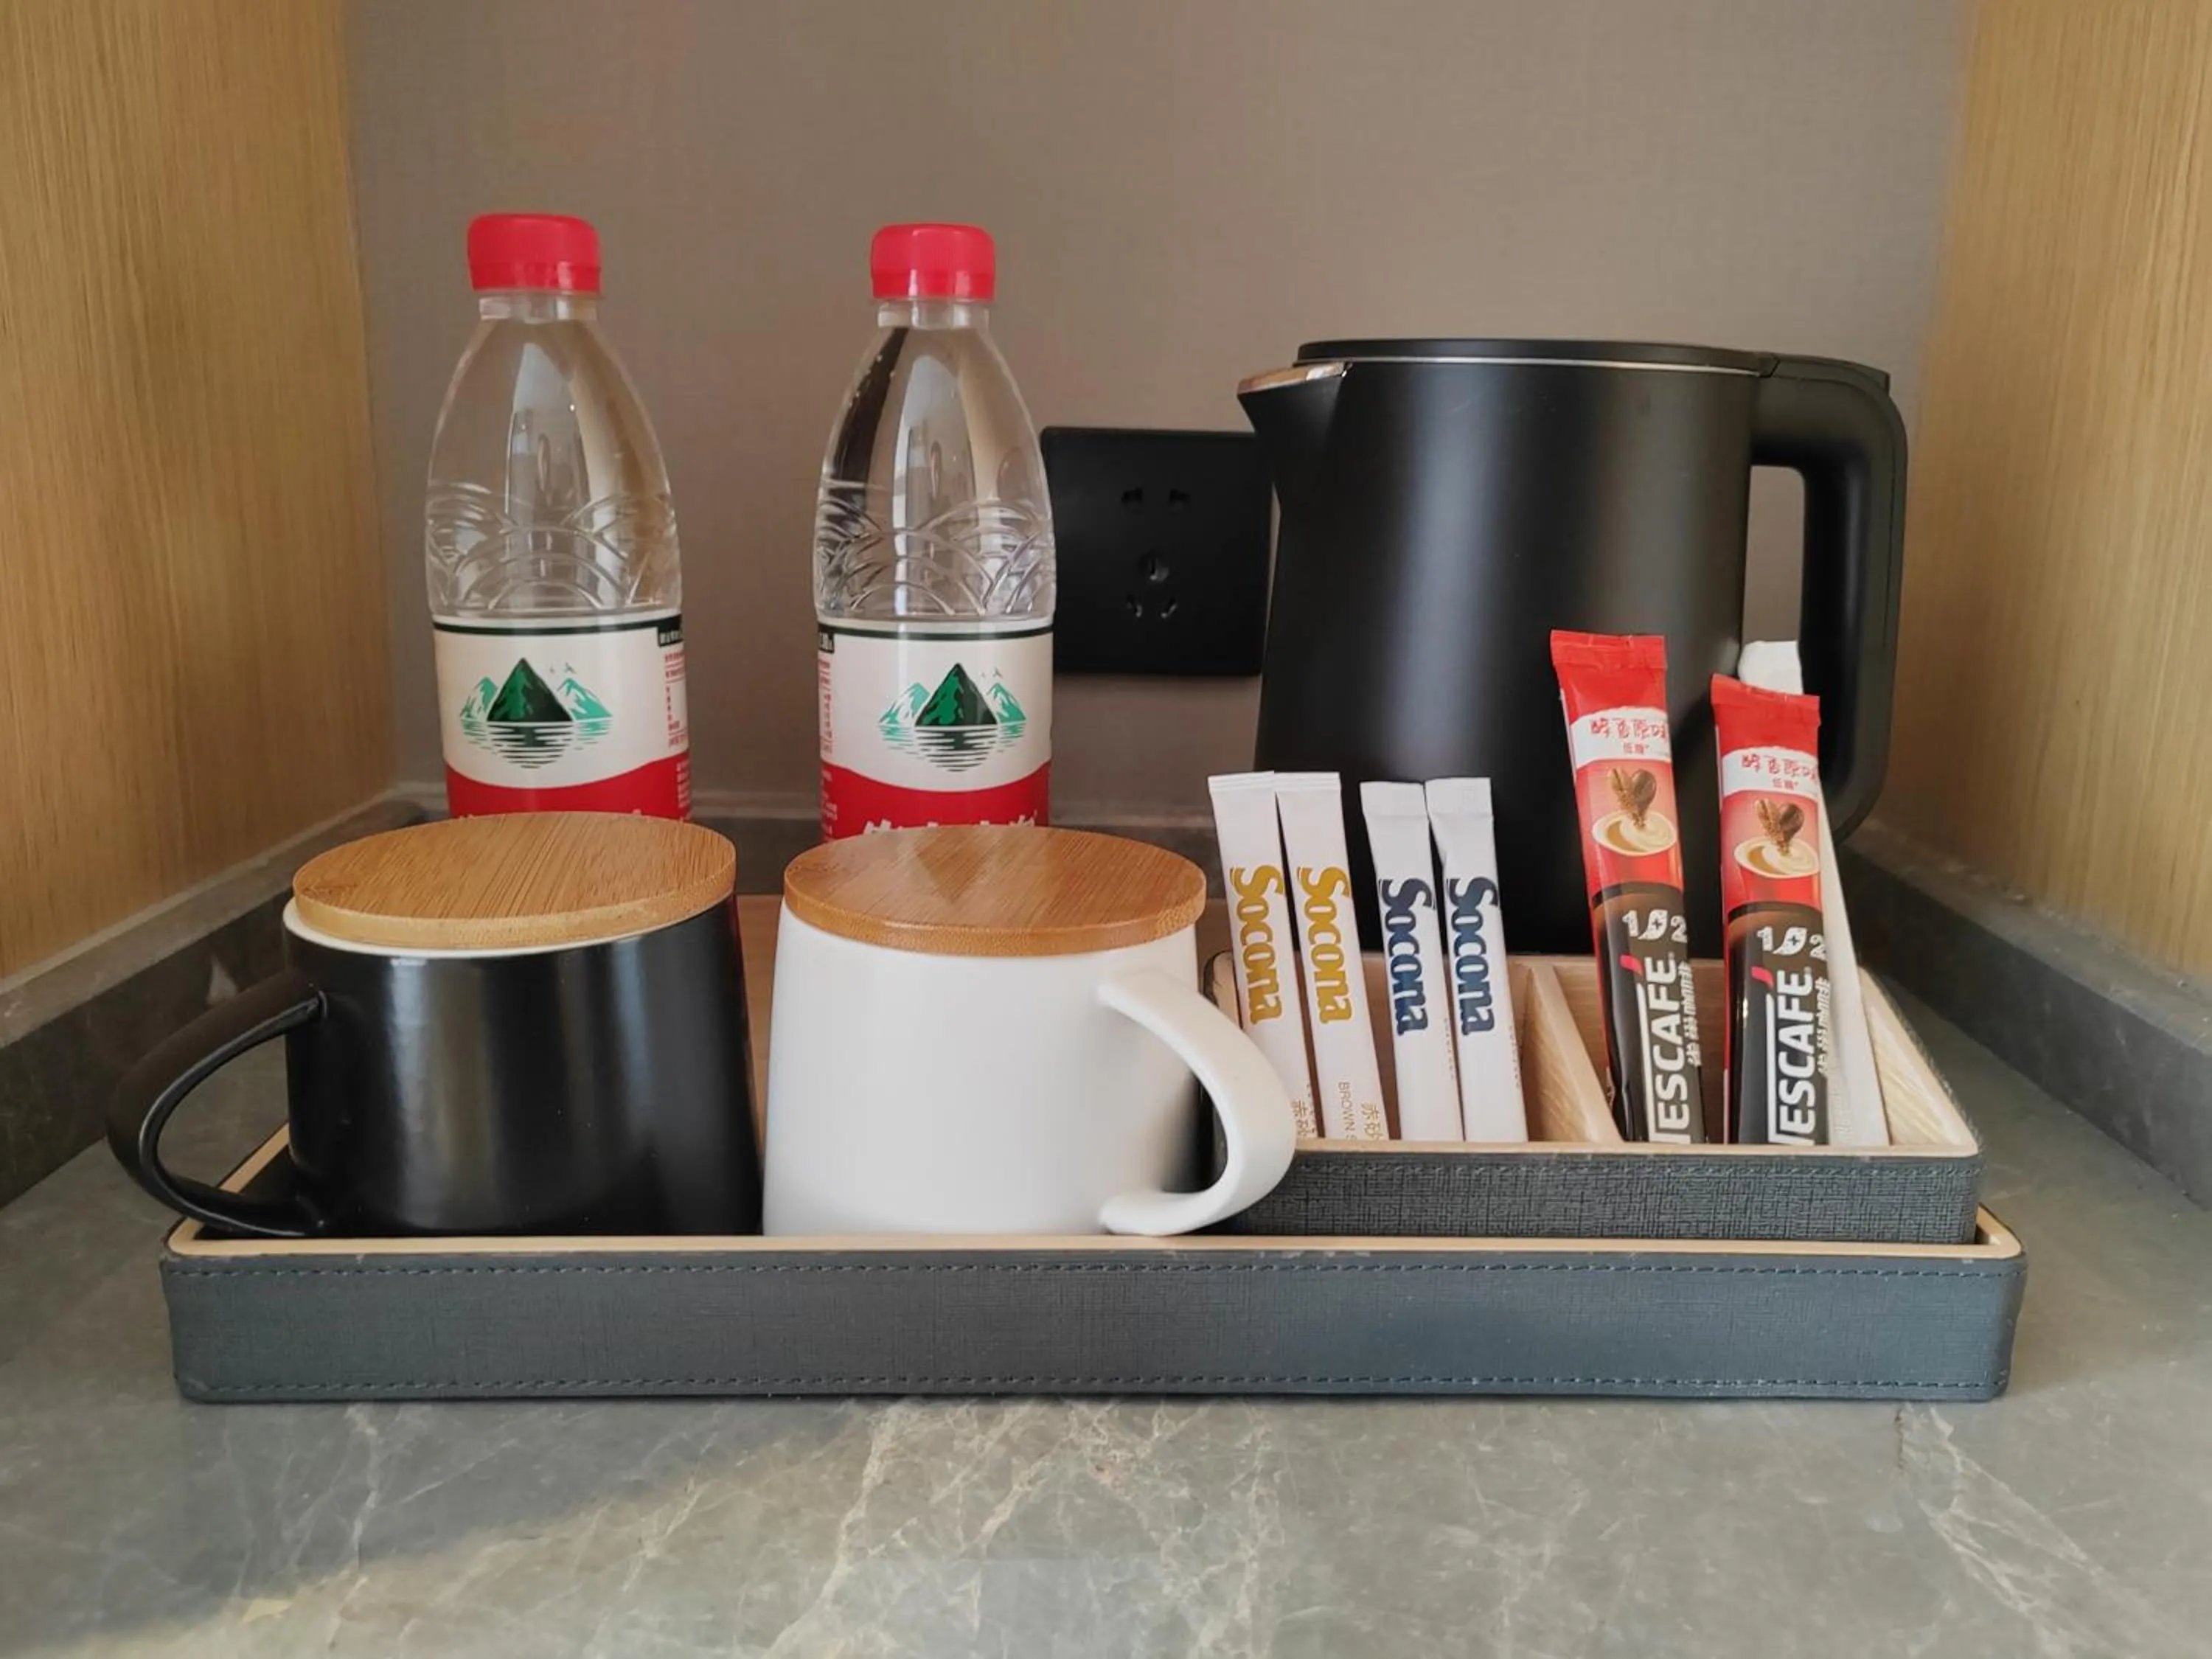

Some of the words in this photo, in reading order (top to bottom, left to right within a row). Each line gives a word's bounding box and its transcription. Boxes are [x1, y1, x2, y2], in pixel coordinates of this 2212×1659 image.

[1229, 864, 1284, 1025] Socona
[1297, 866, 1352, 1024] Socona
[1378, 877, 1437, 1036] Socona
[1446, 876, 1500, 1036] Socona
[1338, 1081, 1356, 1132] BROWN
